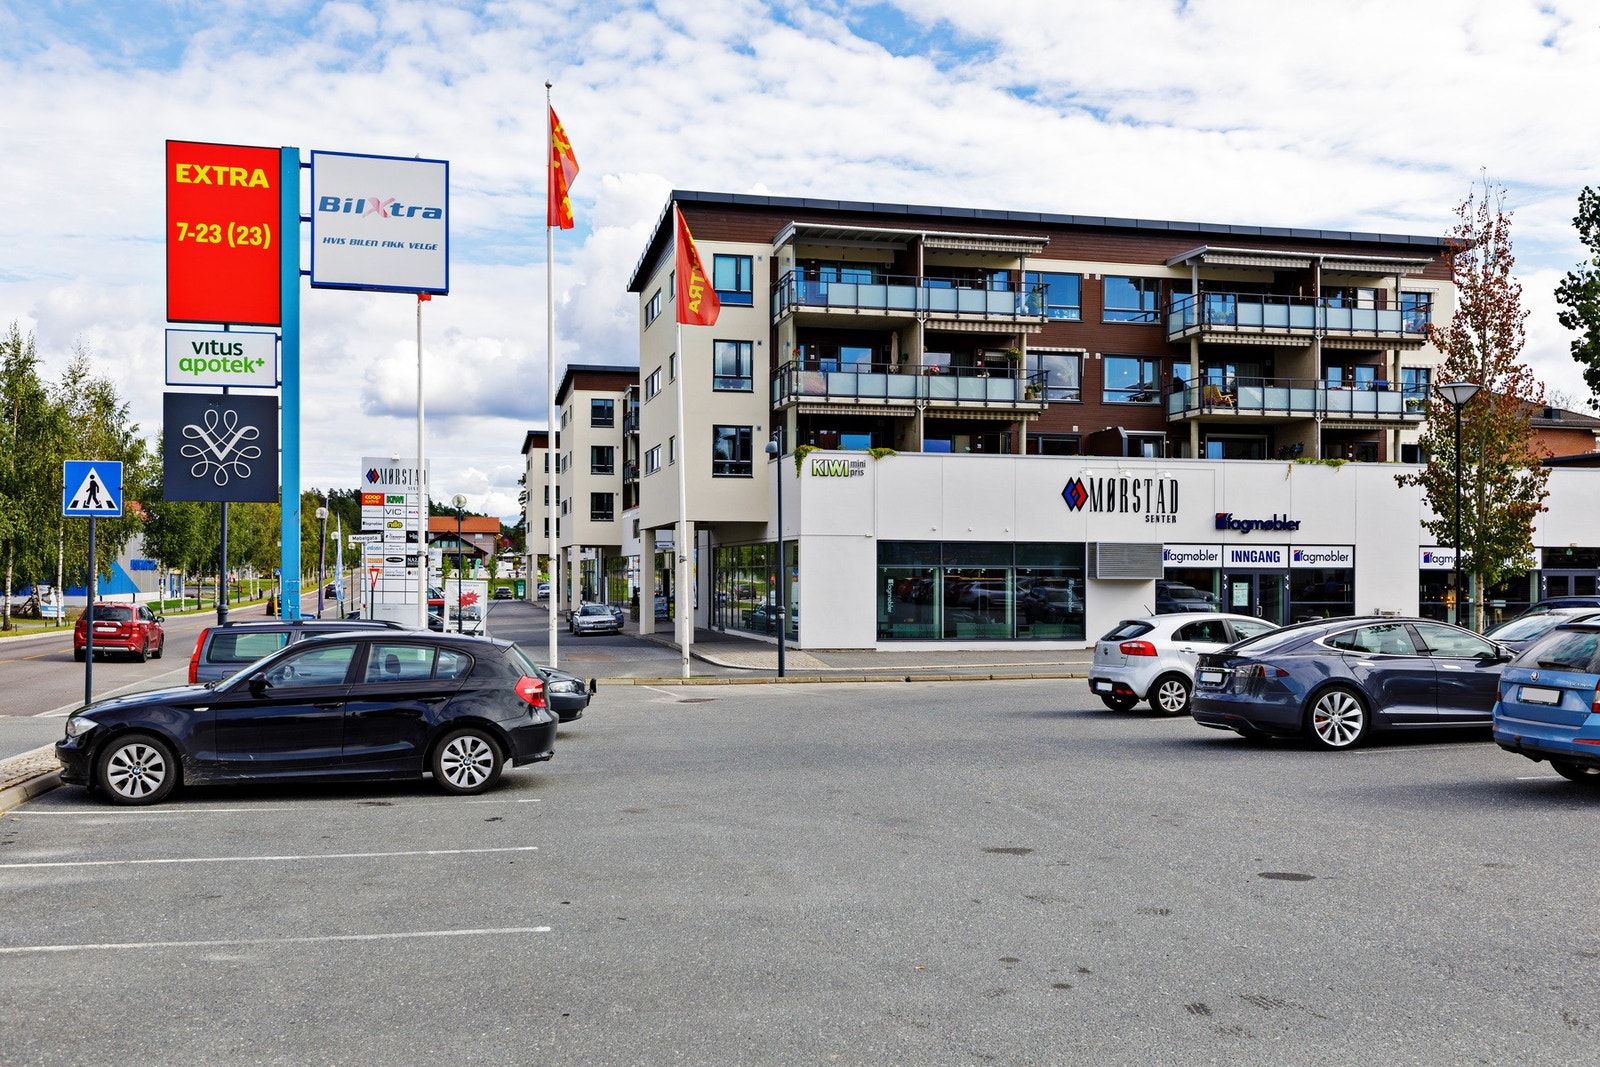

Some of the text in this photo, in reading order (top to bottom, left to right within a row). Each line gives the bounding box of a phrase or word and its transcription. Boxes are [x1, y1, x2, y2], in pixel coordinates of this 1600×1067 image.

[176, 163, 270, 188] EXTRA
[319, 196, 443, 219] BilXtra
[176, 221, 271, 250] 7-23 (23)
[322, 237, 438, 251] HVIS BILEN FIKK VELGE
[191, 339, 244, 356] vitus
[812, 459, 866, 477] KIWI mini
[850, 468, 864, 477] pris
[1089, 477, 1179, 513] MØRSTAD
[1145, 515, 1177, 523] SENTER
[1227, 513, 1301, 534] fagmøbler
[1167, 549, 1218, 563] fagmøbler
[1231, 550, 1281, 562] INNGANG
[1300, 550, 1349, 564] fagmøbler
